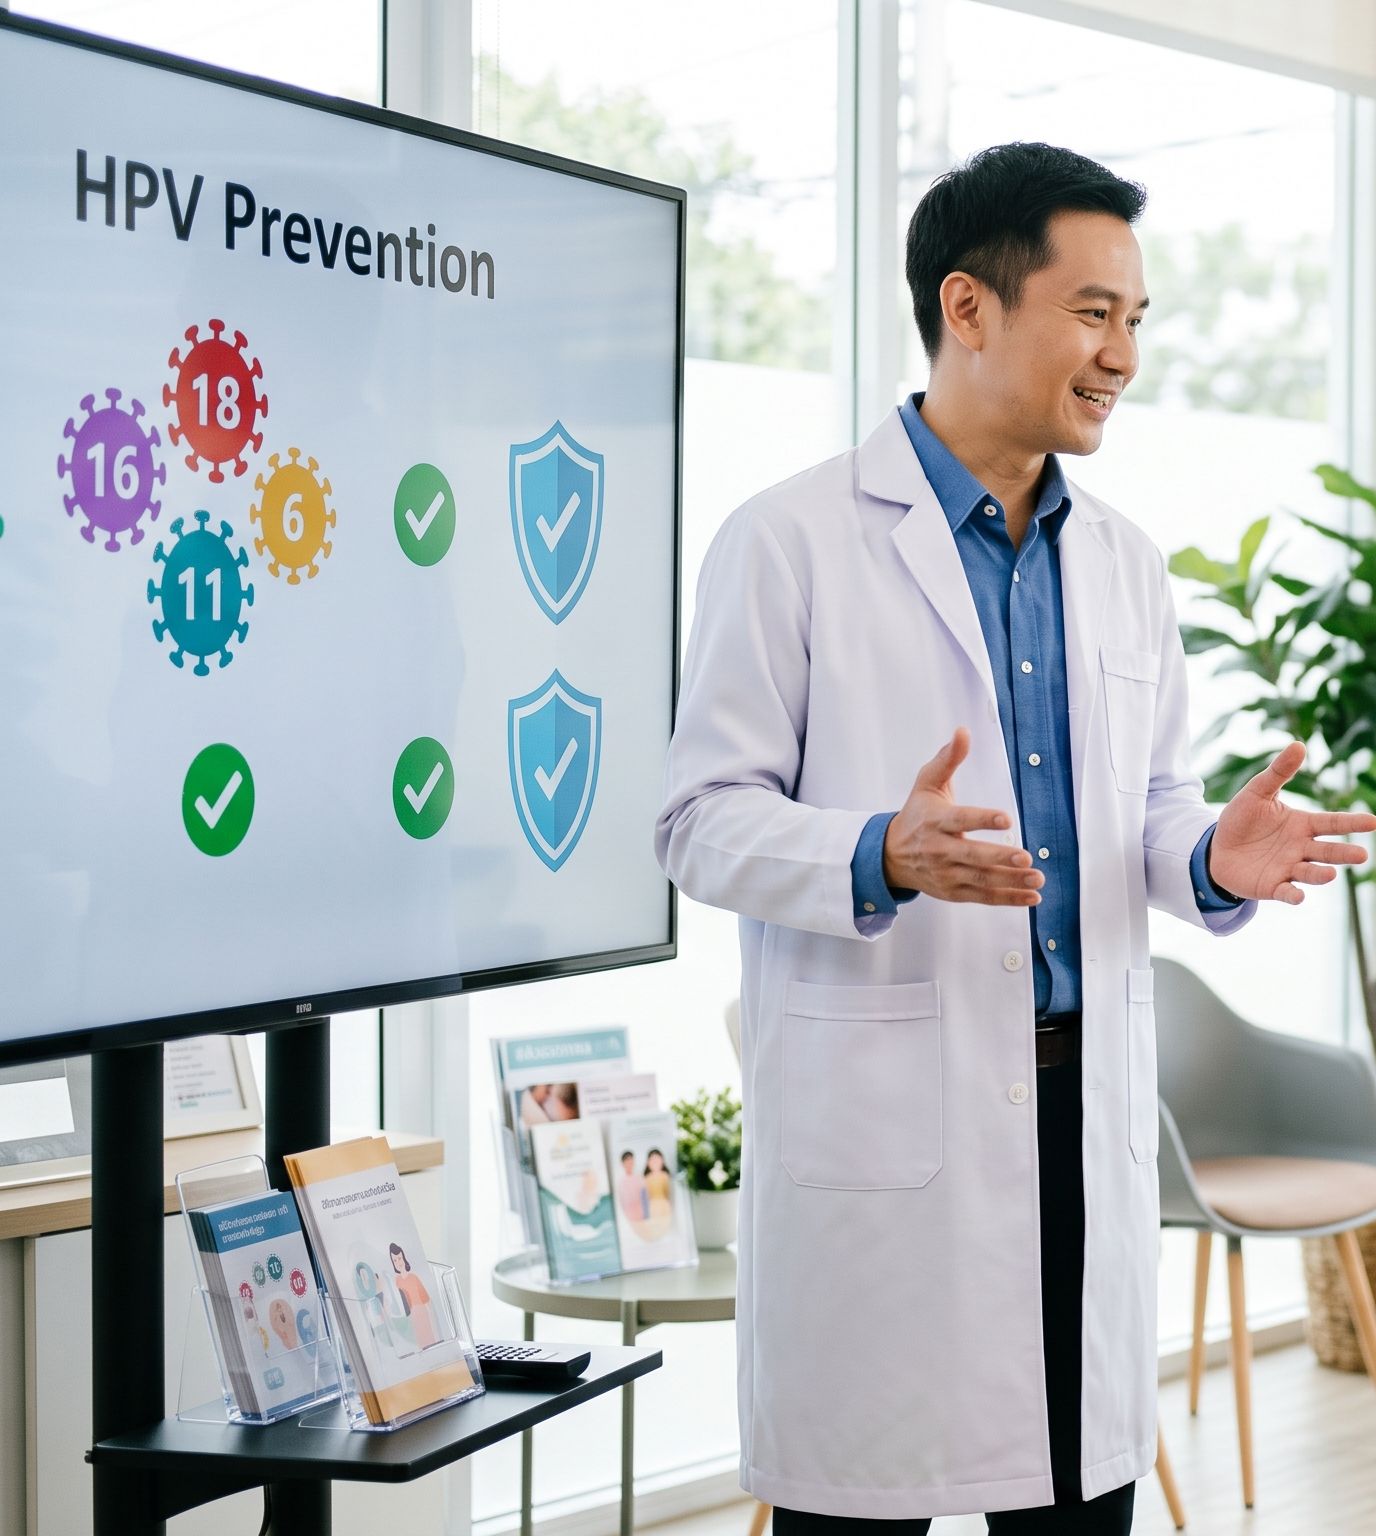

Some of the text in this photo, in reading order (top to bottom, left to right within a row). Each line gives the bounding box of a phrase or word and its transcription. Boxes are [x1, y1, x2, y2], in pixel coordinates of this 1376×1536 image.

[76, 148, 495, 300] HPV Prevention
[192, 373, 241, 430] 18
[86, 442, 140, 500] 16
[282, 493, 304, 542] 6
[178, 568, 221, 620] 11
